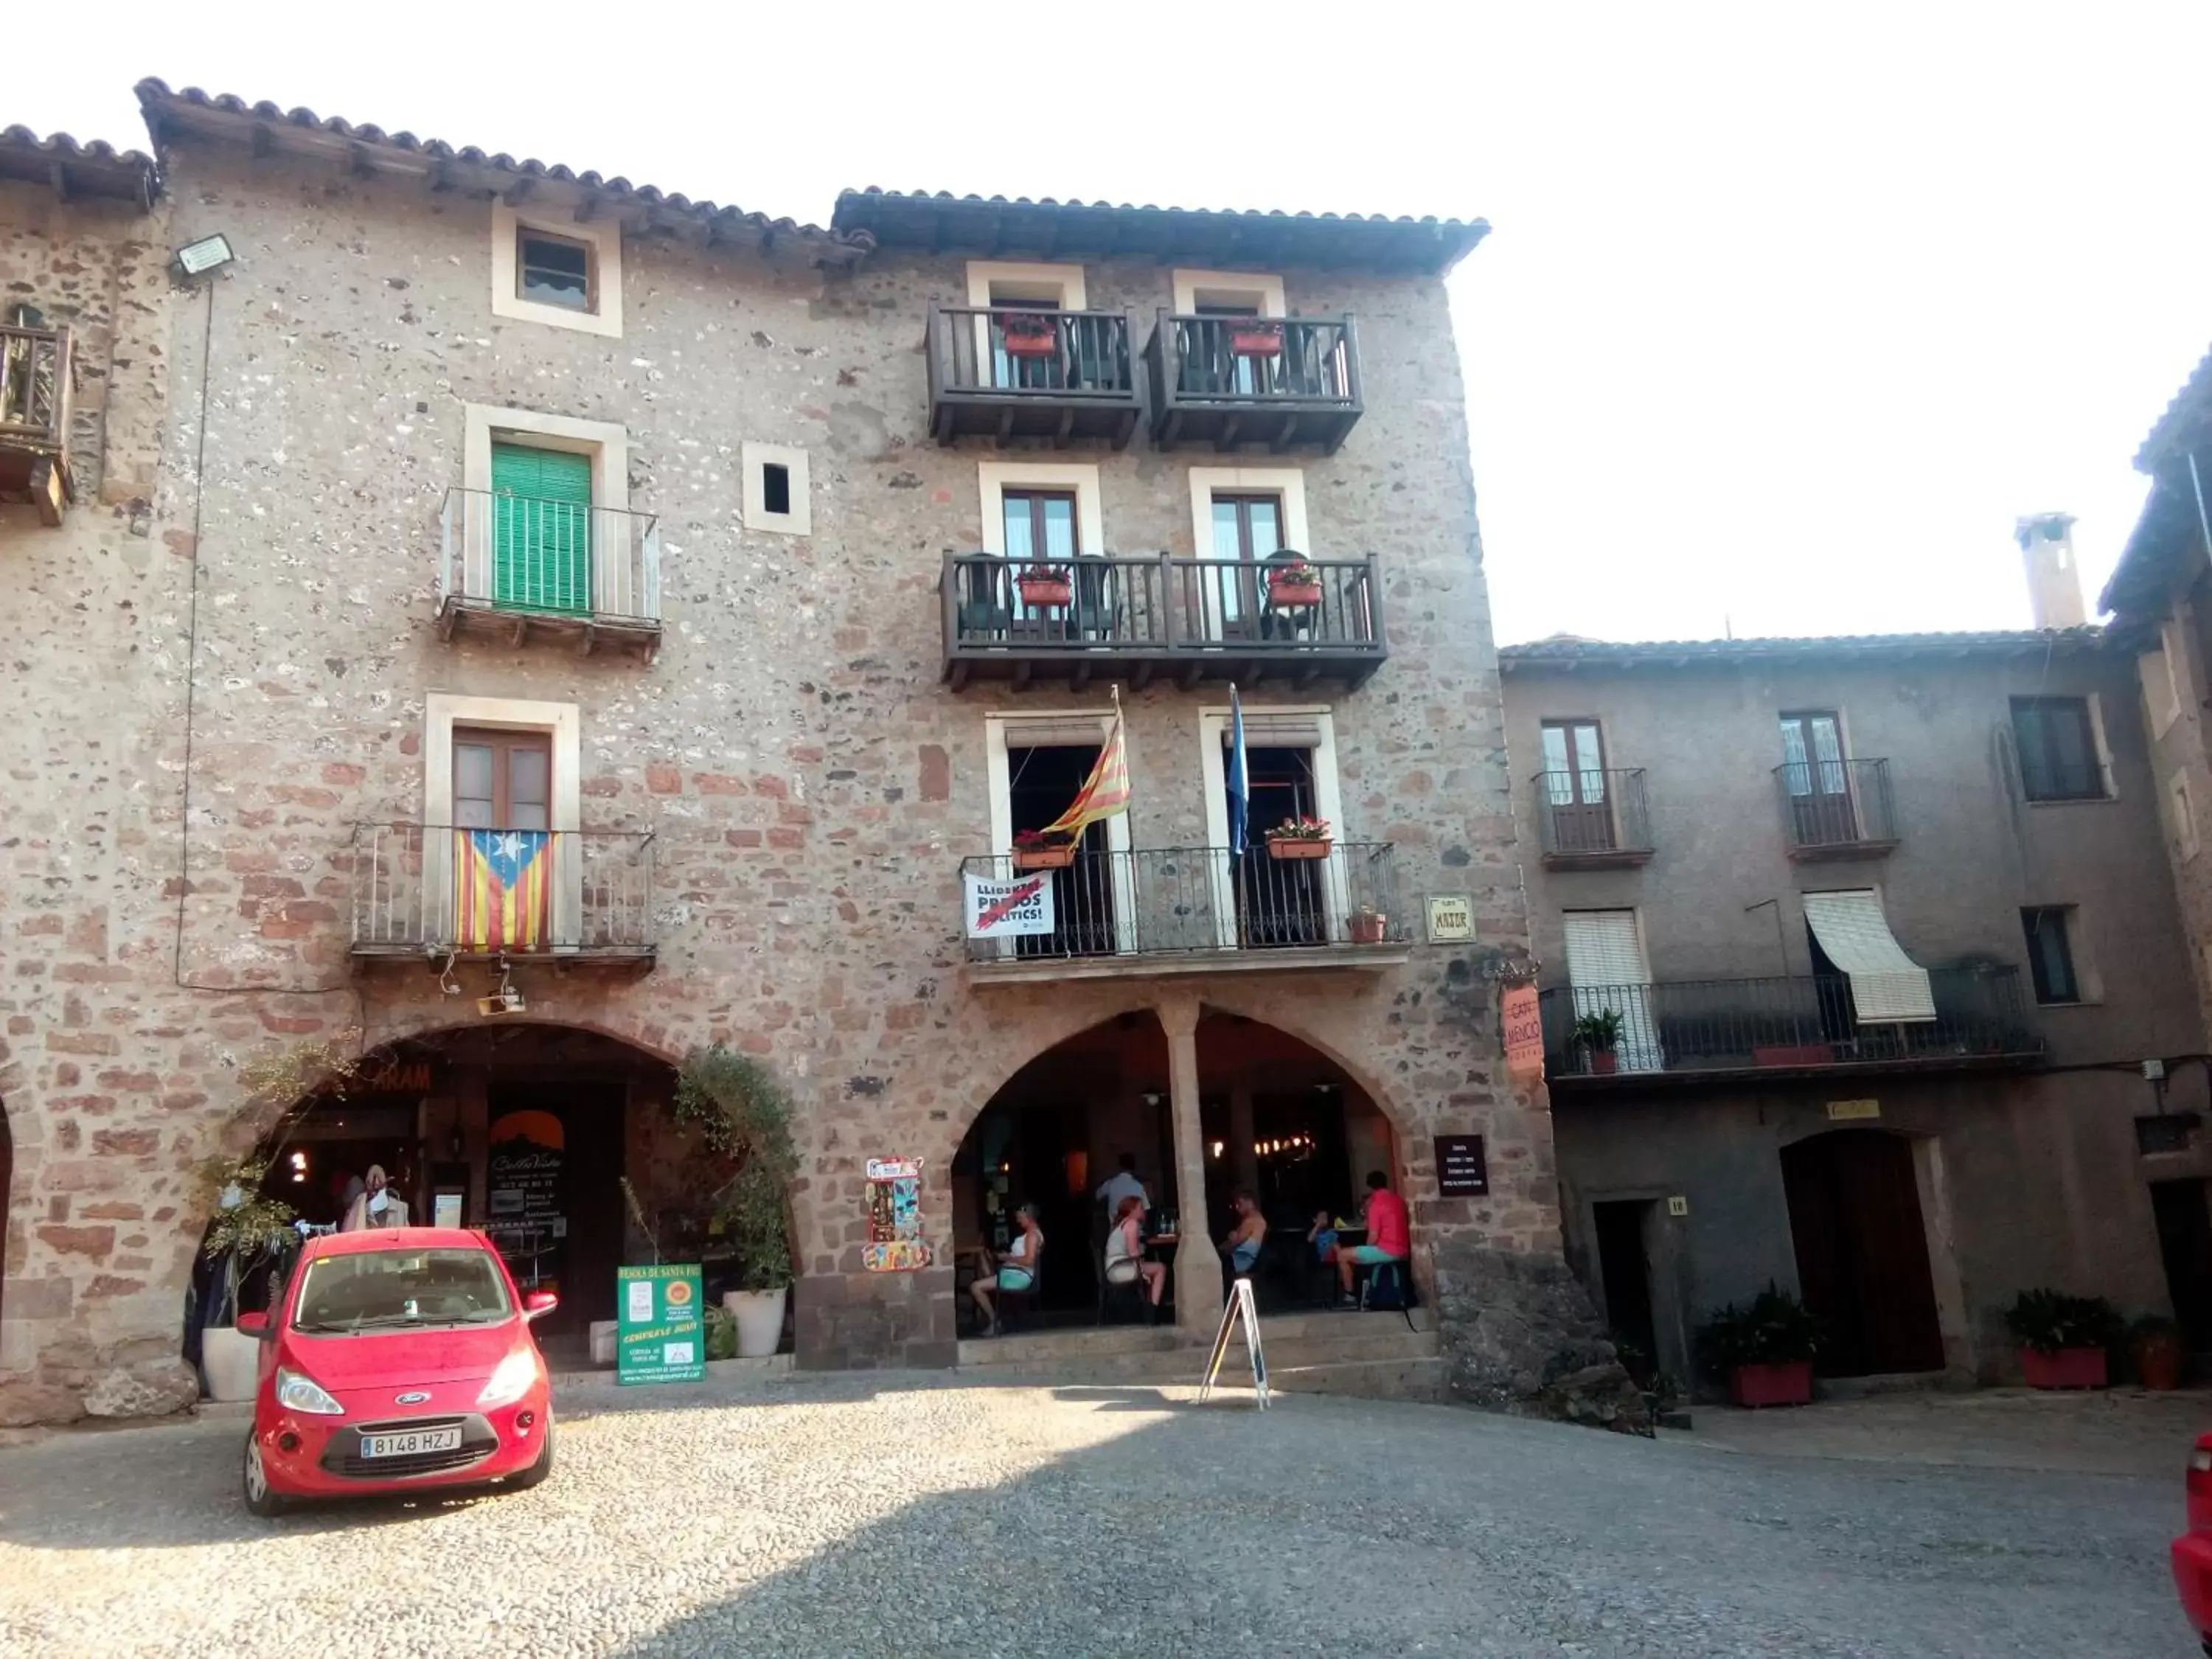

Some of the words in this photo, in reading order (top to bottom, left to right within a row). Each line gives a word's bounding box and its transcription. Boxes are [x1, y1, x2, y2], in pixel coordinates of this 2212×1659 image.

[978, 894, 1041, 909] PROS
[978, 908, 1043, 922] LTICS!
[375, 1436, 417, 1453] 8148
[422, 1430, 453, 1449] HZJ
